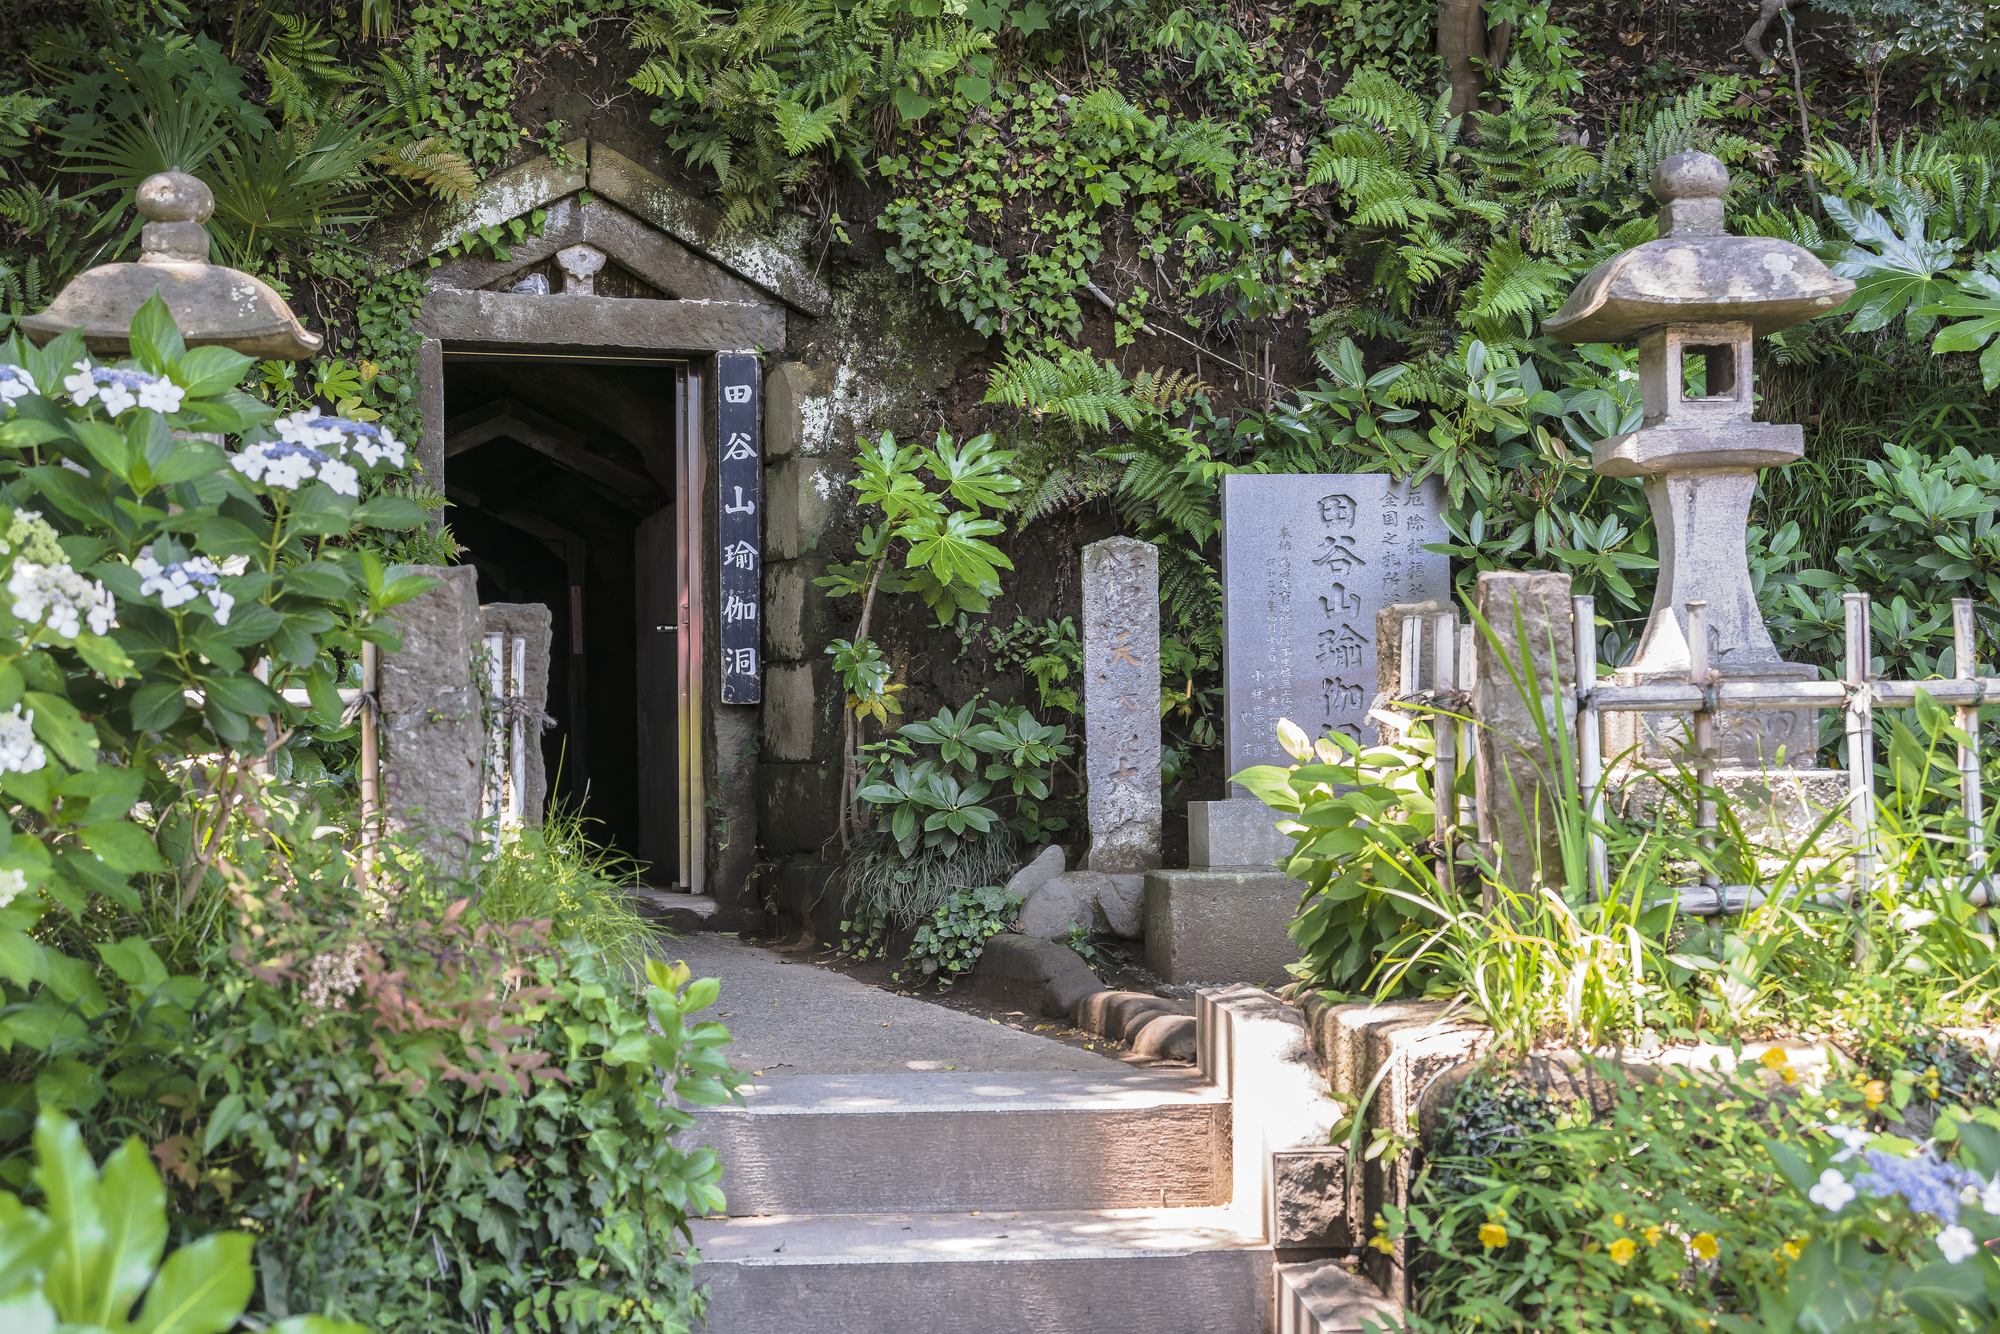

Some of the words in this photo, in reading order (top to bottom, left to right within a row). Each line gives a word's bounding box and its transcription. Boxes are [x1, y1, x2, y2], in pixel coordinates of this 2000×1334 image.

[722, 384, 758, 676] 田谷山瑜伽洞
